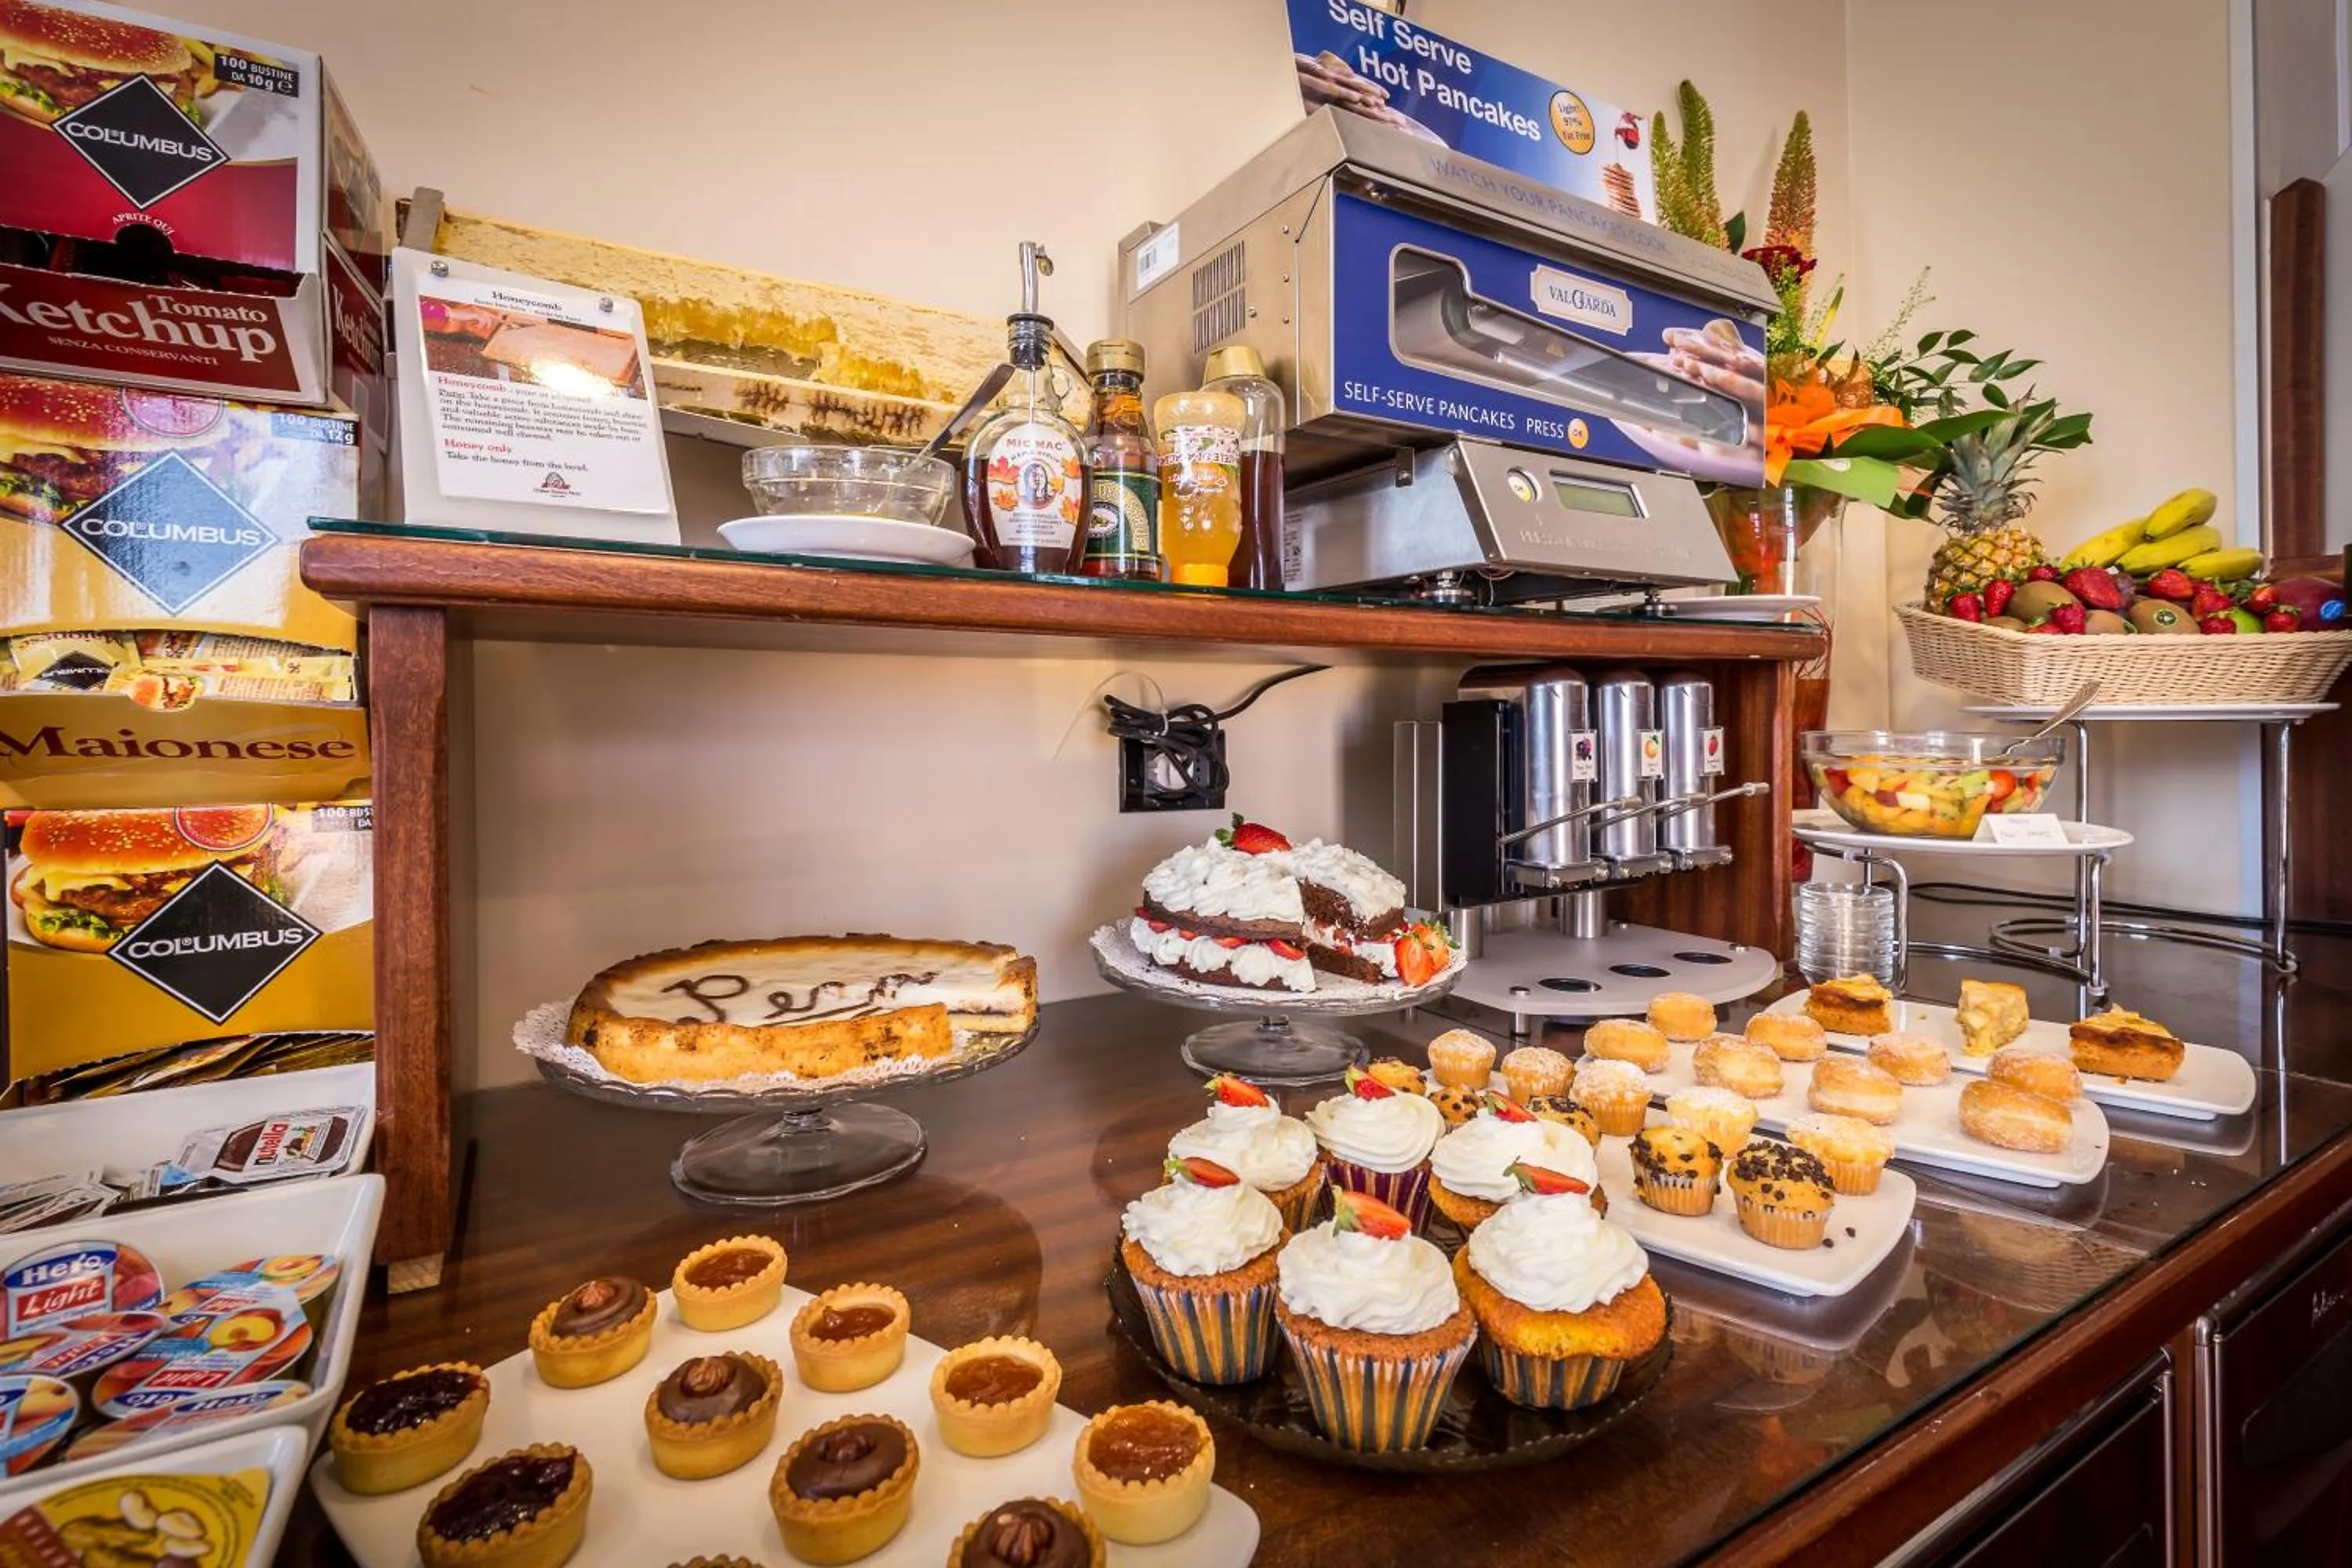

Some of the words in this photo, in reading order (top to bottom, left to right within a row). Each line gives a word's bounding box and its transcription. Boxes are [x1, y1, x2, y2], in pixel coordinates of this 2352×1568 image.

[1329, 0, 1385, 40] Self
[1394, 20, 1472, 74] Serve
[220, 56, 248, 70] 100
[250, 64, 295, 82] BUSTINE
[231, 71, 245, 82] DA
[1359, 45, 1410, 91] Hot
[1419, 71, 1541, 142] Pancakes
[65, 122, 213, 162] COLUMBUS
[1430, 157, 1496, 192] WATCH
[1501, 181, 1544, 210] YOUR
[112, 212, 152, 225] APRITE
[153, 219, 176, 235] QUI
[147, 294, 268, 323] Tomato
[47, 336, 103, 352] SENZA
[103, 343, 219, 366] CONSERVANTI
[1344, 381, 1435, 415] SELF-SERVE
[1439, 401, 1515, 430] PANCAKES
[1526, 418, 1565, 439] PRESS
[80, 517, 261, 547] COLUMBUS
[0, 726, 357, 760] Maionese
[127, 928, 303, 959] COLUMBUS
[253, 1122, 289, 1166] nutella
[21, 1252, 103, 1286] Hero
[23, 1278, 101, 1316] Light
